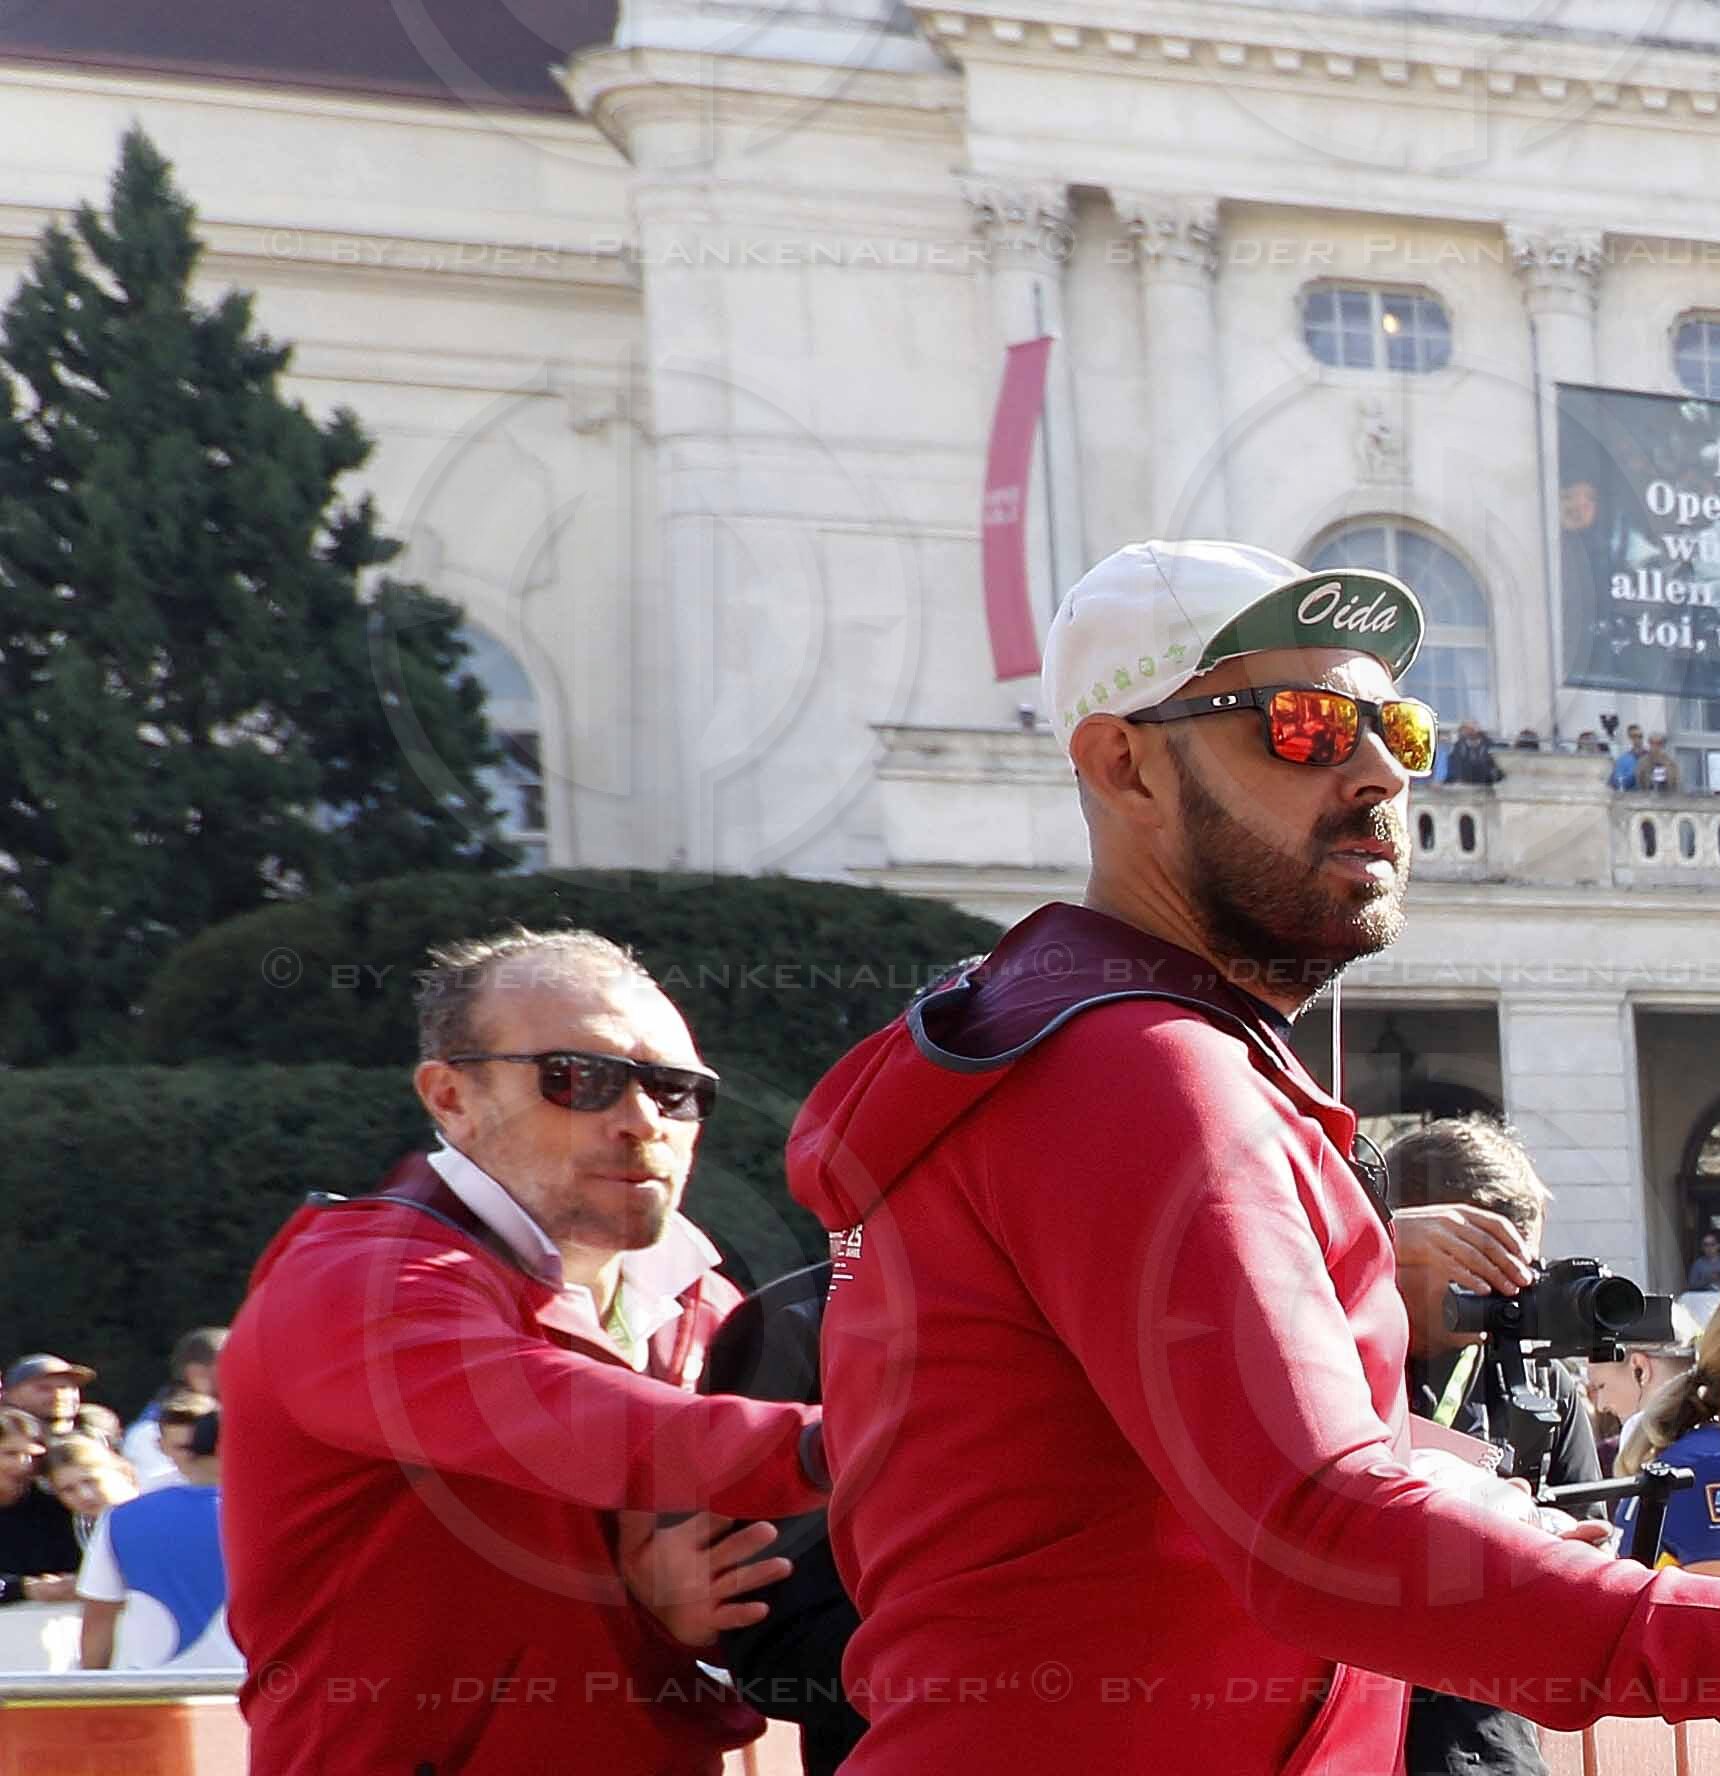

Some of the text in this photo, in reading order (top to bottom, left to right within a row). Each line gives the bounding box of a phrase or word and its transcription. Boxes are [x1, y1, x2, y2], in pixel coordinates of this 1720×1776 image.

[1297, 581, 1399, 633] Oida
[1610, 570, 1713, 608] allen
[1637, 614, 1706, 653] toi,
